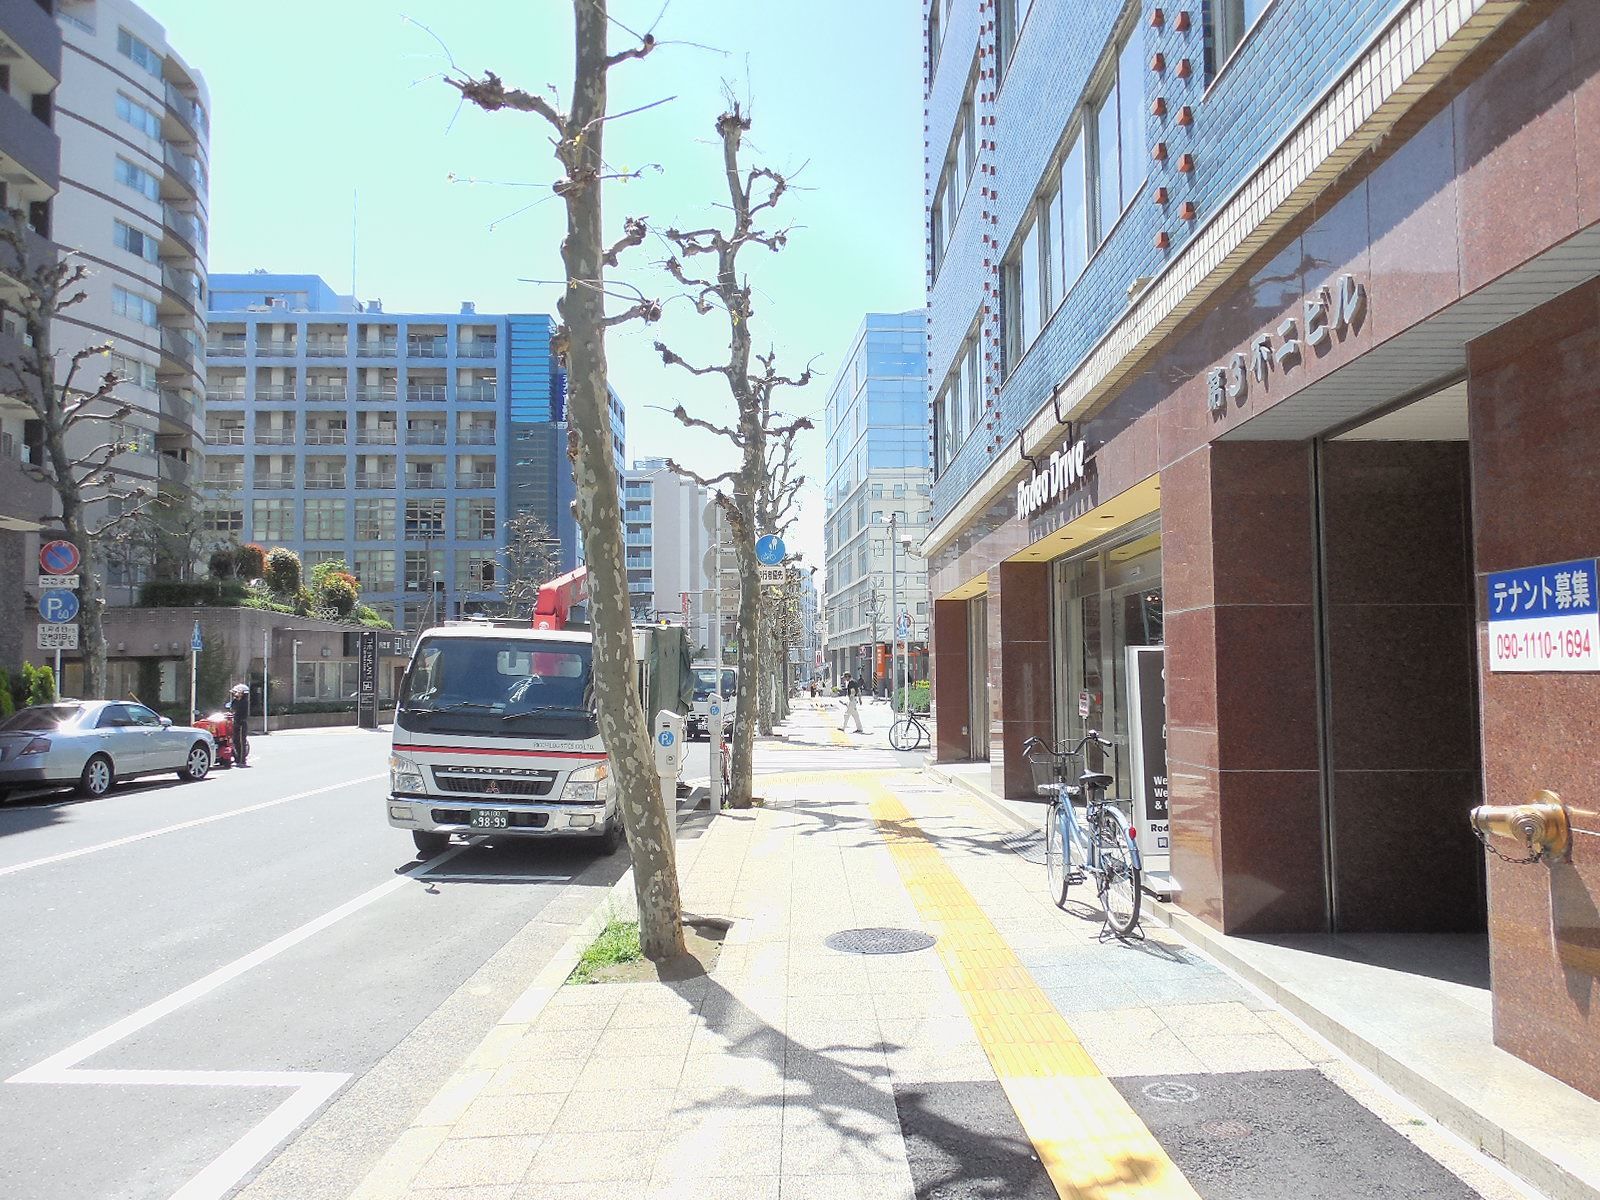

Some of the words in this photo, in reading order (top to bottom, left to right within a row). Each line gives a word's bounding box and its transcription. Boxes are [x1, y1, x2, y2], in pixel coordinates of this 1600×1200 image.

[1018, 468, 1050, 520] Rodeo
[1050, 440, 1086, 498] Drive
[1494, 569, 1590, 613] テナント募集
[47, 598, 63, 619] P
[1497, 628, 1591, 660] 090-1110-1694
[447, 766, 540, 775] CANTER
[1155, 800, 1162, 809] &
[478, 816, 507, 828] 98-99
[1151, 824, 1168, 832] Rod
